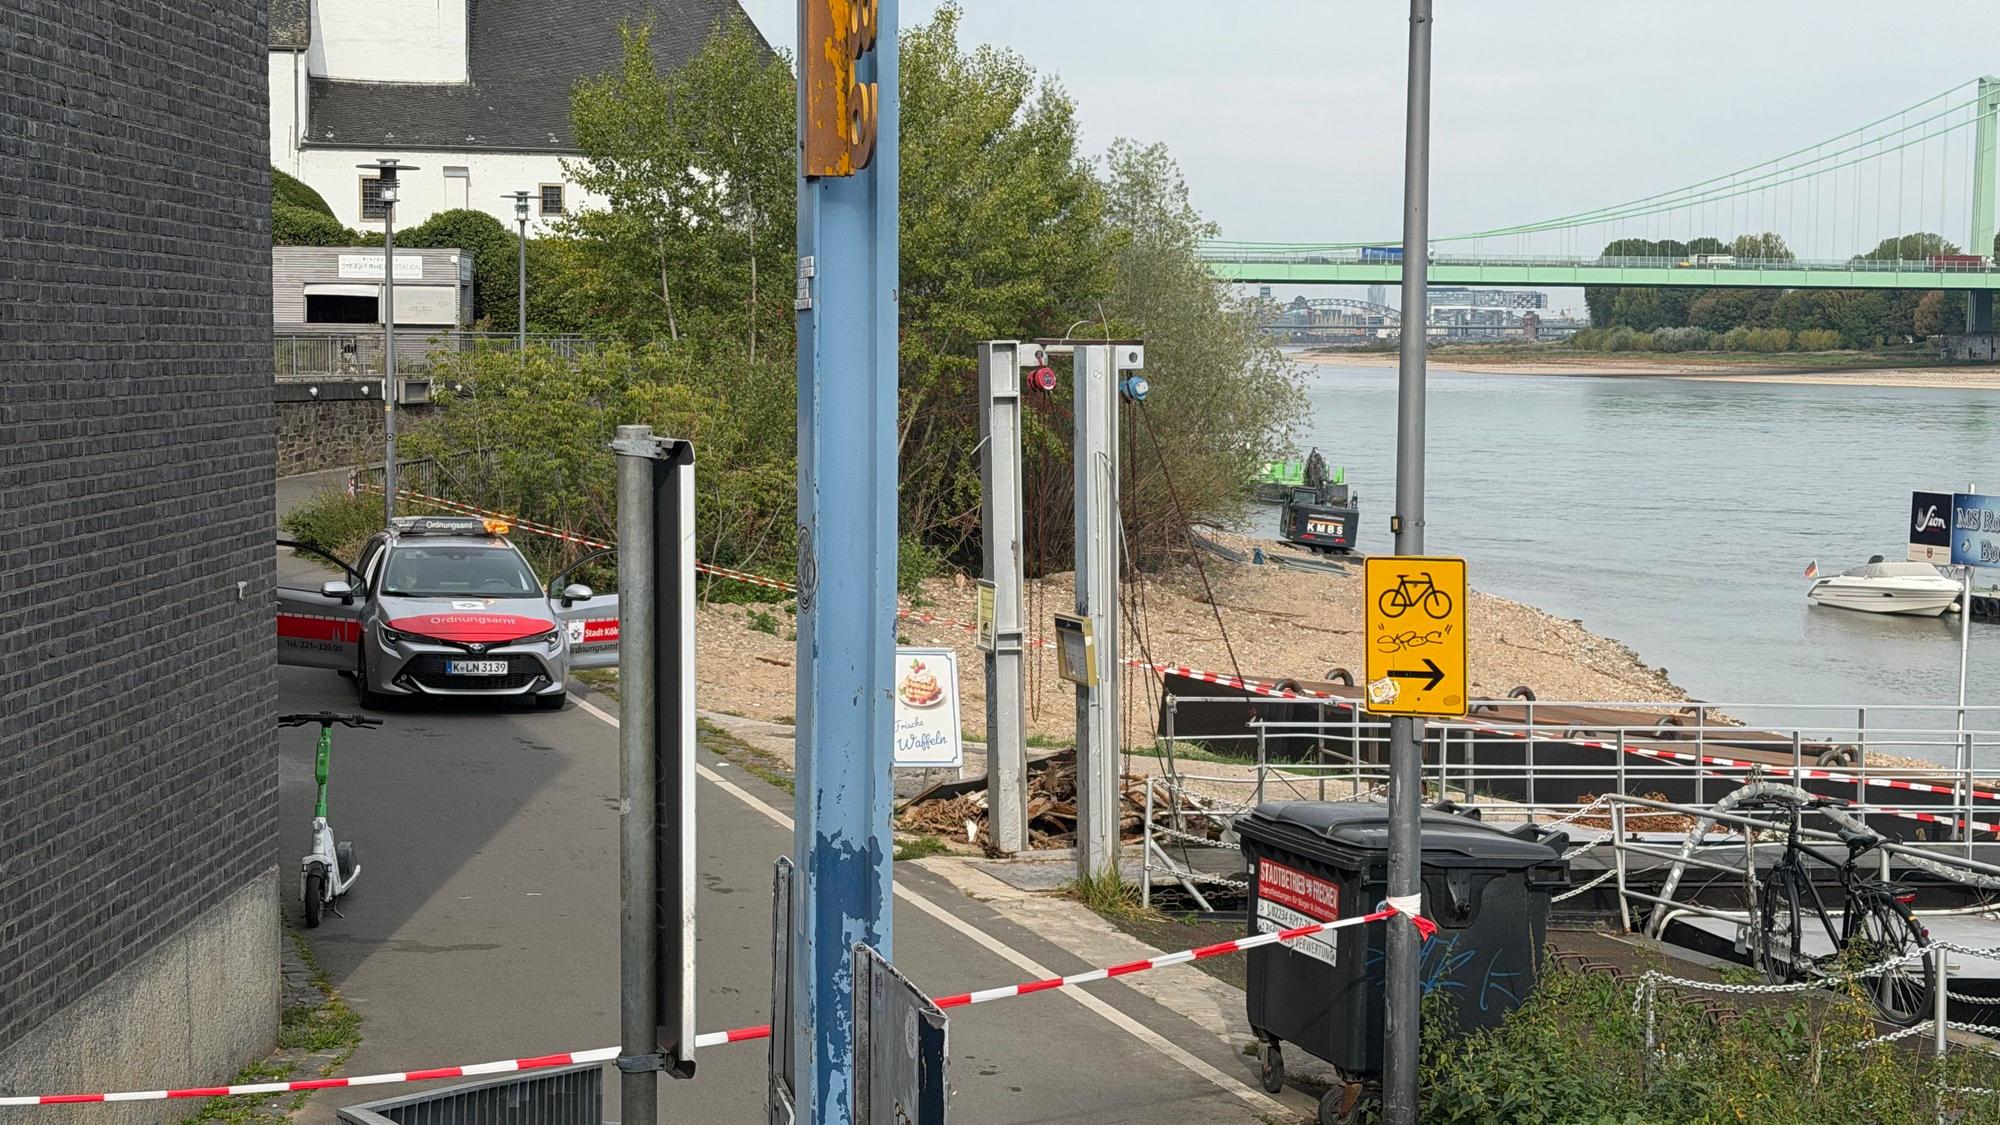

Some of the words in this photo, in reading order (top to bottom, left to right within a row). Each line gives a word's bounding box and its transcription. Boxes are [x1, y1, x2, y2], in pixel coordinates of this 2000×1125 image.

[426, 520, 473, 530] Ordnungsamt
[1915, 505, 1947, 532] Sion
[1956, 507, 1980, 530] MS
[431, 616, 517, 625] Ordnungsamt
[585, 628, 604, 638] Stadt
[453, 662, 460, 673] K
[481, 662, 507, 673] 3139
[895, 716, 926, 733] Frische
[896, 730, 948, 752] Waffeln
[1260, 861, 1306, 896] STADTBETRIEB
